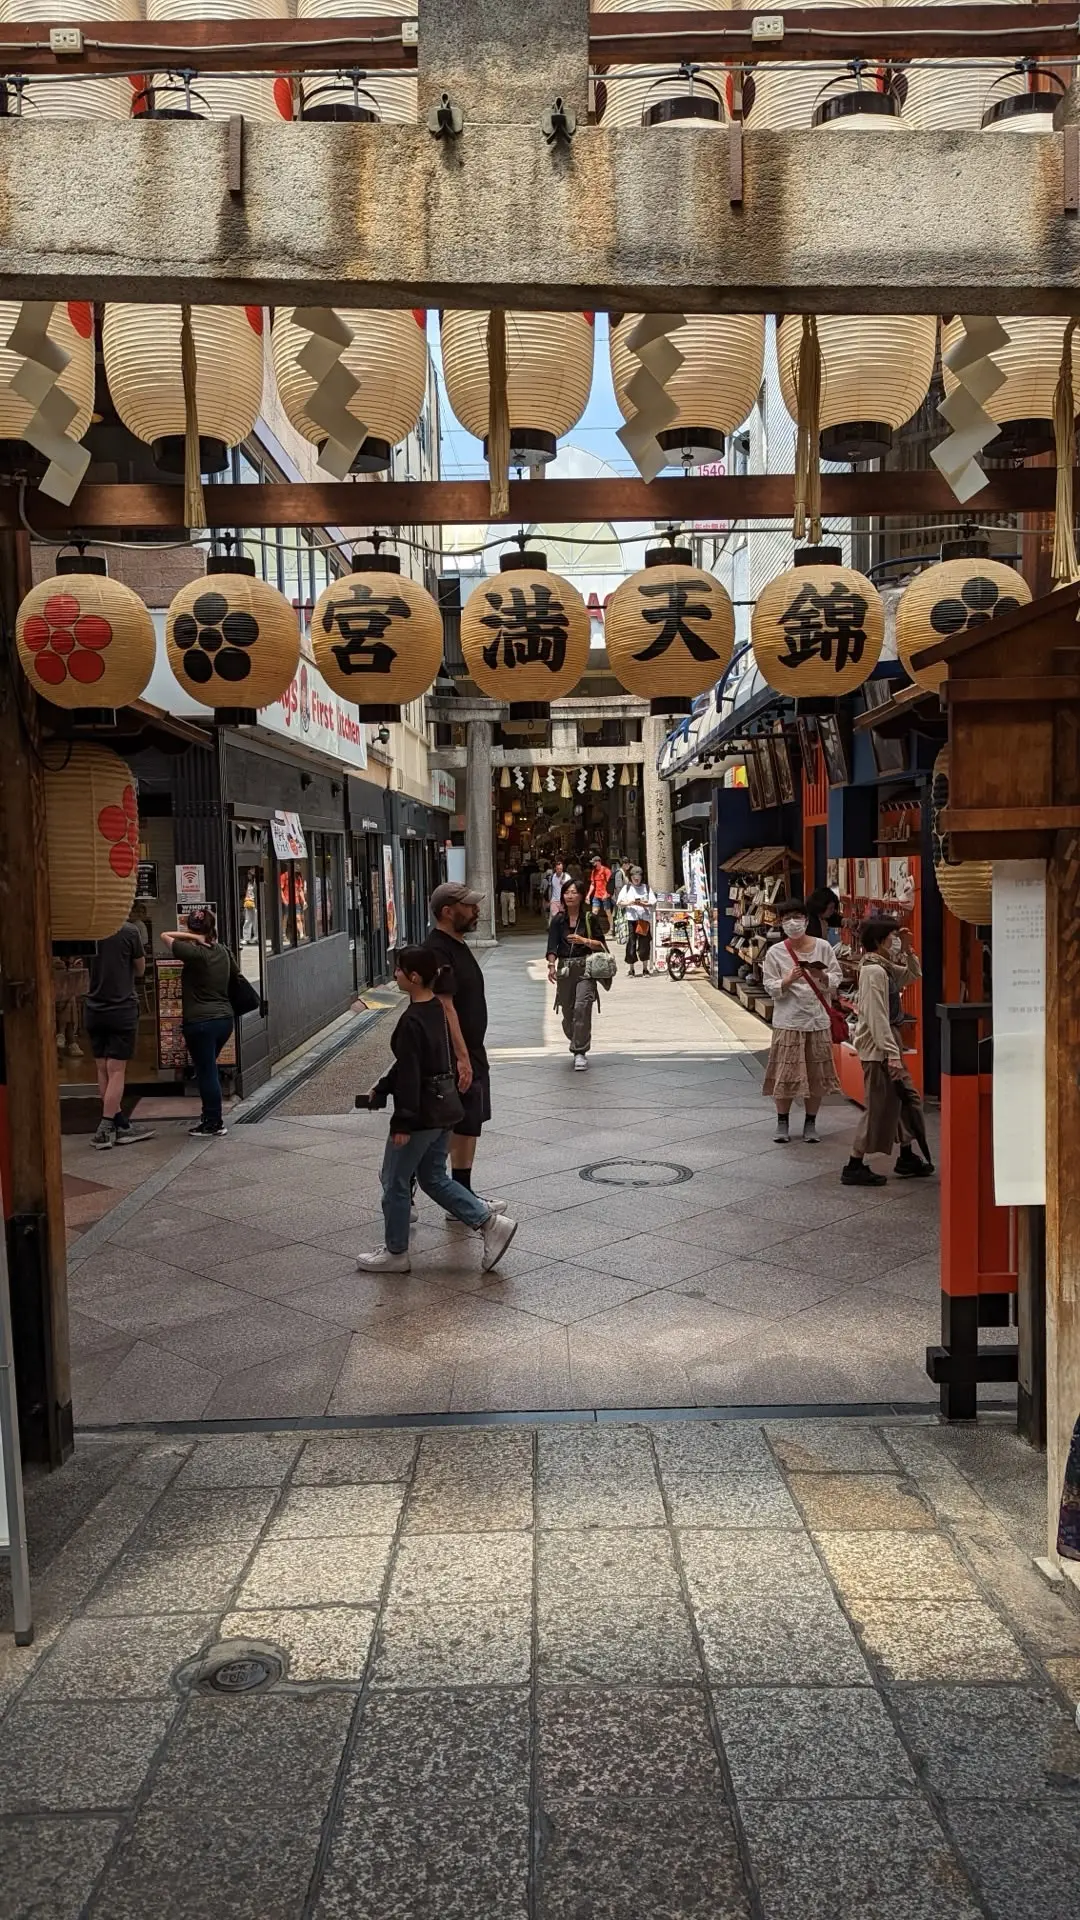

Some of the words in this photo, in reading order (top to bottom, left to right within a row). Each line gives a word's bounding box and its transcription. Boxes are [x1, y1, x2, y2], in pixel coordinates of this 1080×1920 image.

[697, 464, 726, 477] 1540
[322, 584, 412, 675] 宮
[479, 583, 570, 672] 満
[631, 580, 721, 661] 天
[777, 581, 869, 672] 錦
[311, 689, 335, 731] First
